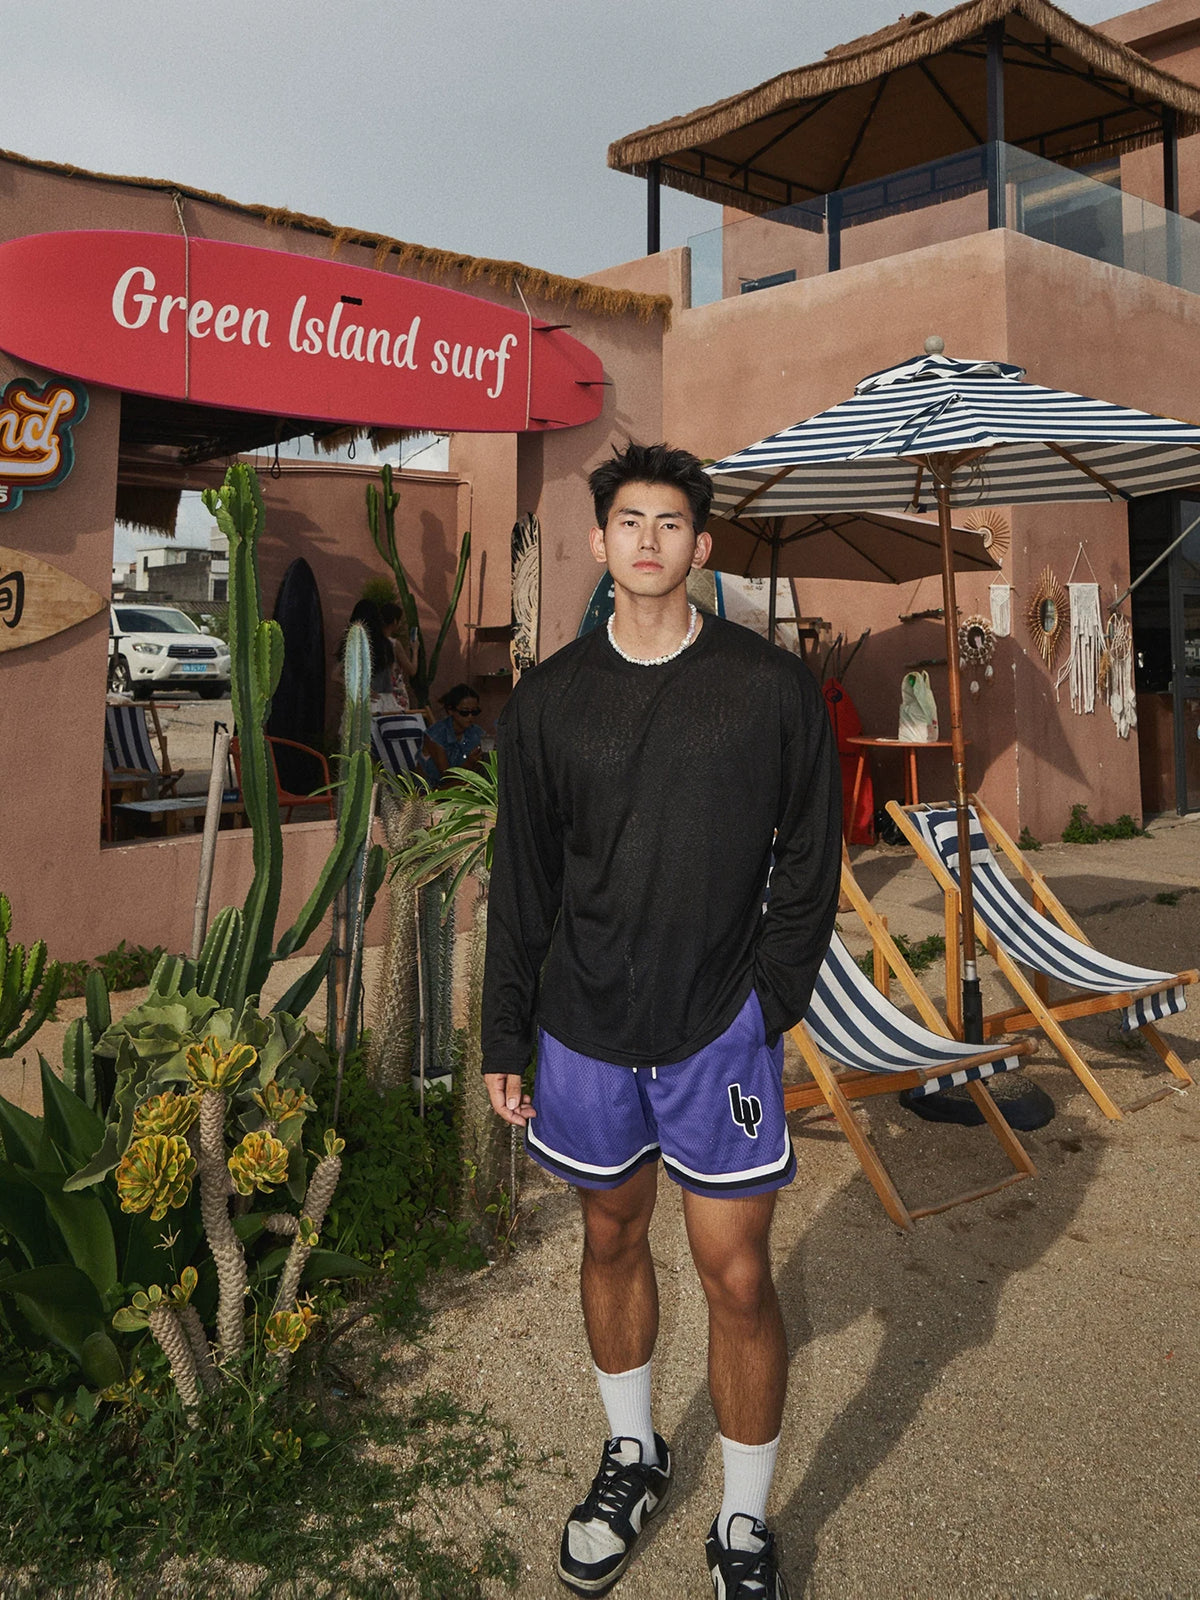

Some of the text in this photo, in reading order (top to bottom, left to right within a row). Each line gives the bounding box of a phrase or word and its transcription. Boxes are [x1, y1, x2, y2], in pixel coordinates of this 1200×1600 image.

[111, 265, 519, 399] Green Island surf
